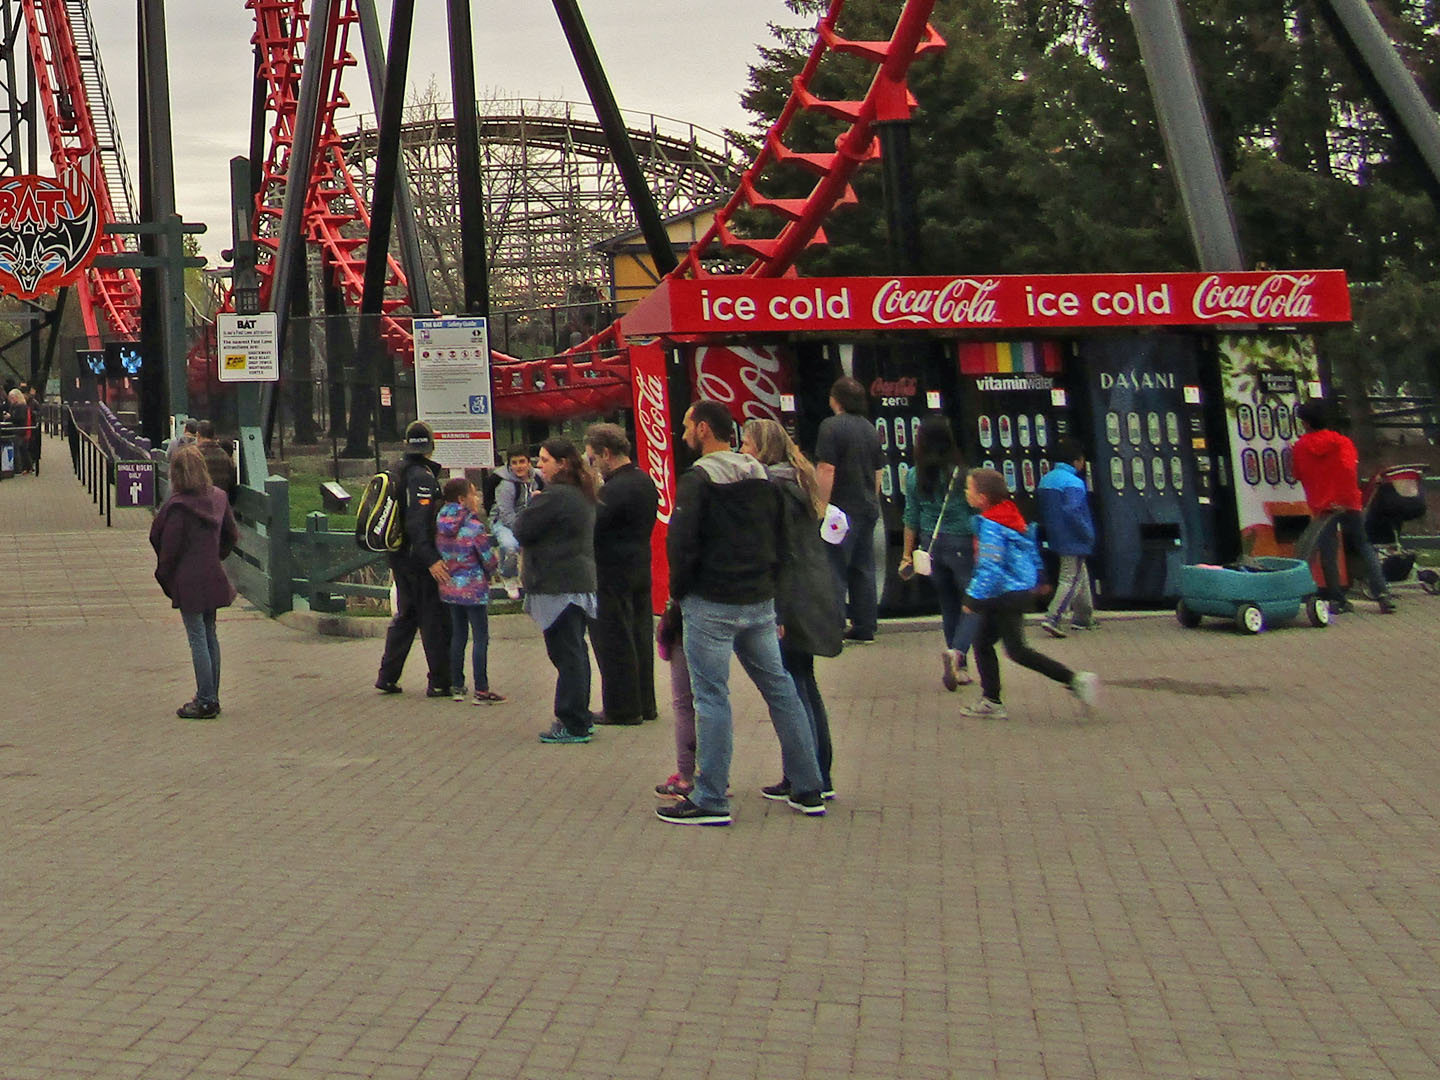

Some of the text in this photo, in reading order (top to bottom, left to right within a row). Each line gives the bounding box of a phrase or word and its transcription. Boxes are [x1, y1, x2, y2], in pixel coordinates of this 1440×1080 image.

[701, 274, 1316, 324] ice cold Coca-Cola ice cold Coca-Cola
[237, 320, 257, 329] BAT
[976, 376, 1054, 391] vitaminwater
[1100, 371, 1175, 390] DASANI
